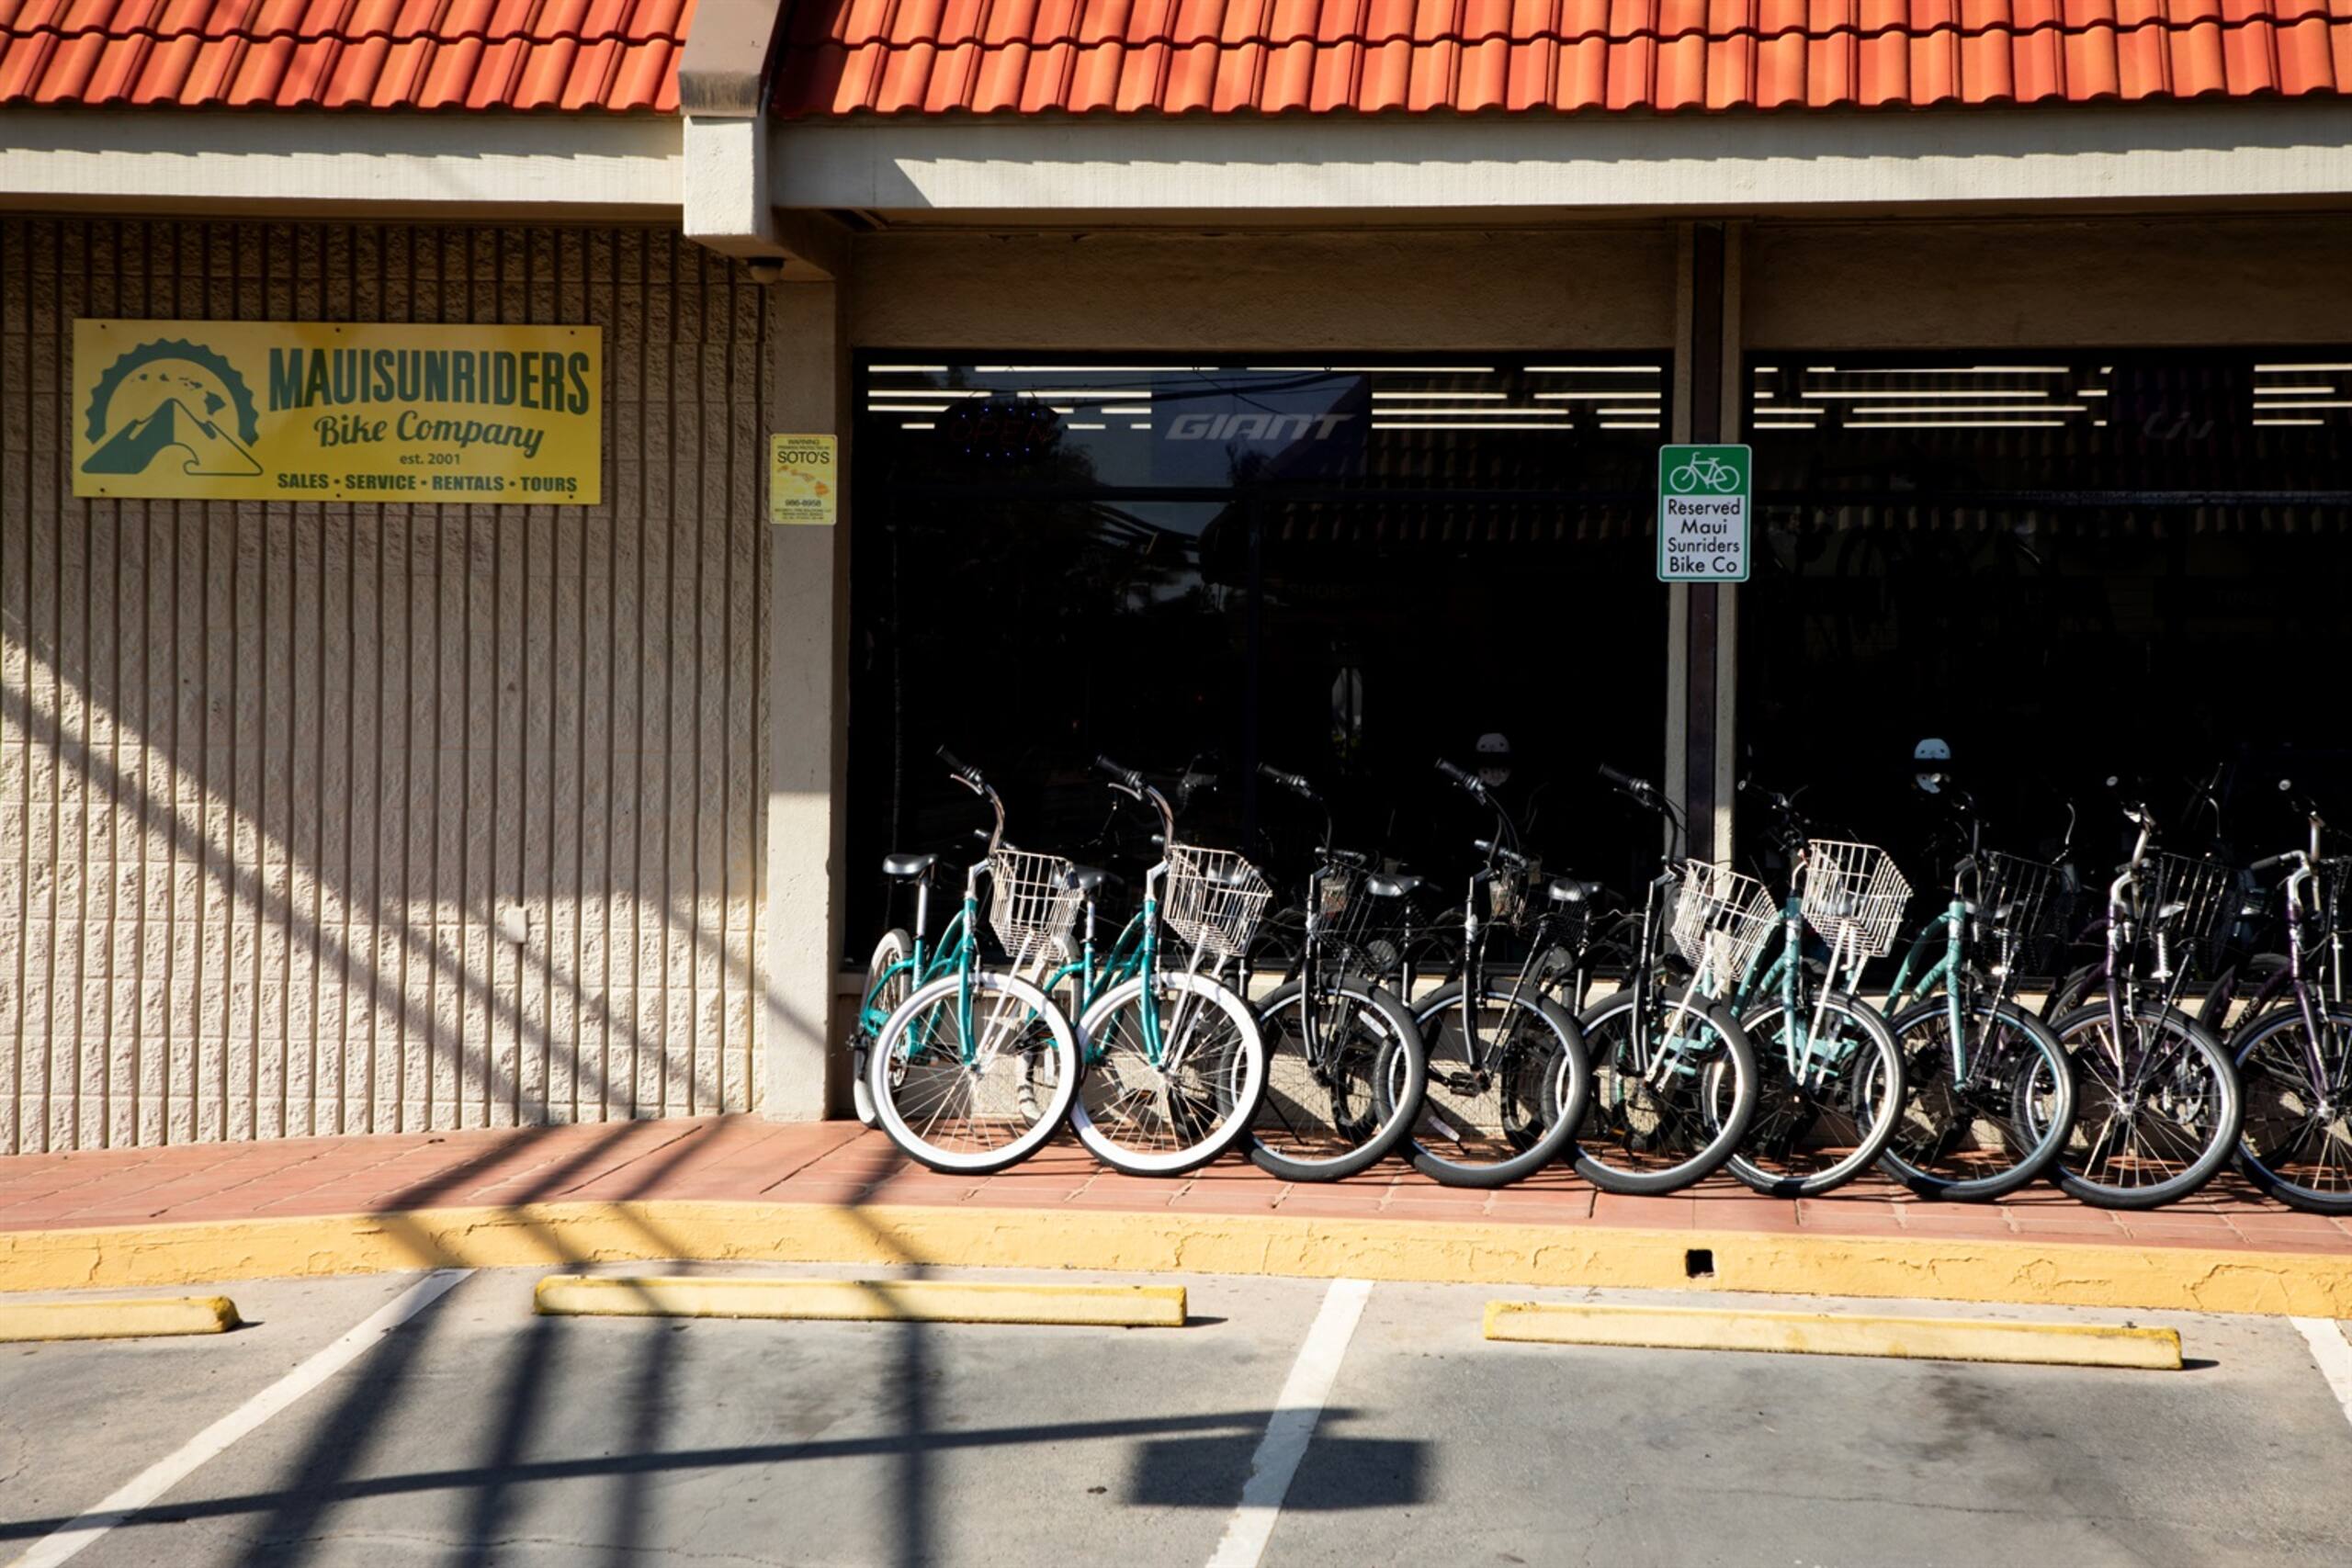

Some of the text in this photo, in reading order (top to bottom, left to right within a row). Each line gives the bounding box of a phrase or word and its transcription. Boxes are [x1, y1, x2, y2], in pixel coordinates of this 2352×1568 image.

[268, 347, 589, 415] MAUISUNRIDERS
[313, 410, 545, 458] Bike Company
[1164, 412, 1356, 441] GIANT
[399, 453, 460, 466] est. 2001
[777, 451, 830, 464] SOTO'S
[277, 473, 578, 492] SALES SERVICE RENTALS TOURS
[1668, 498, 1740, 514] Reserved
[1680, 519, 1727, 534] Maui
[1668, 536, 1740, 552] Sunriders
[1669, 556, 1737, 572] Bike Co
